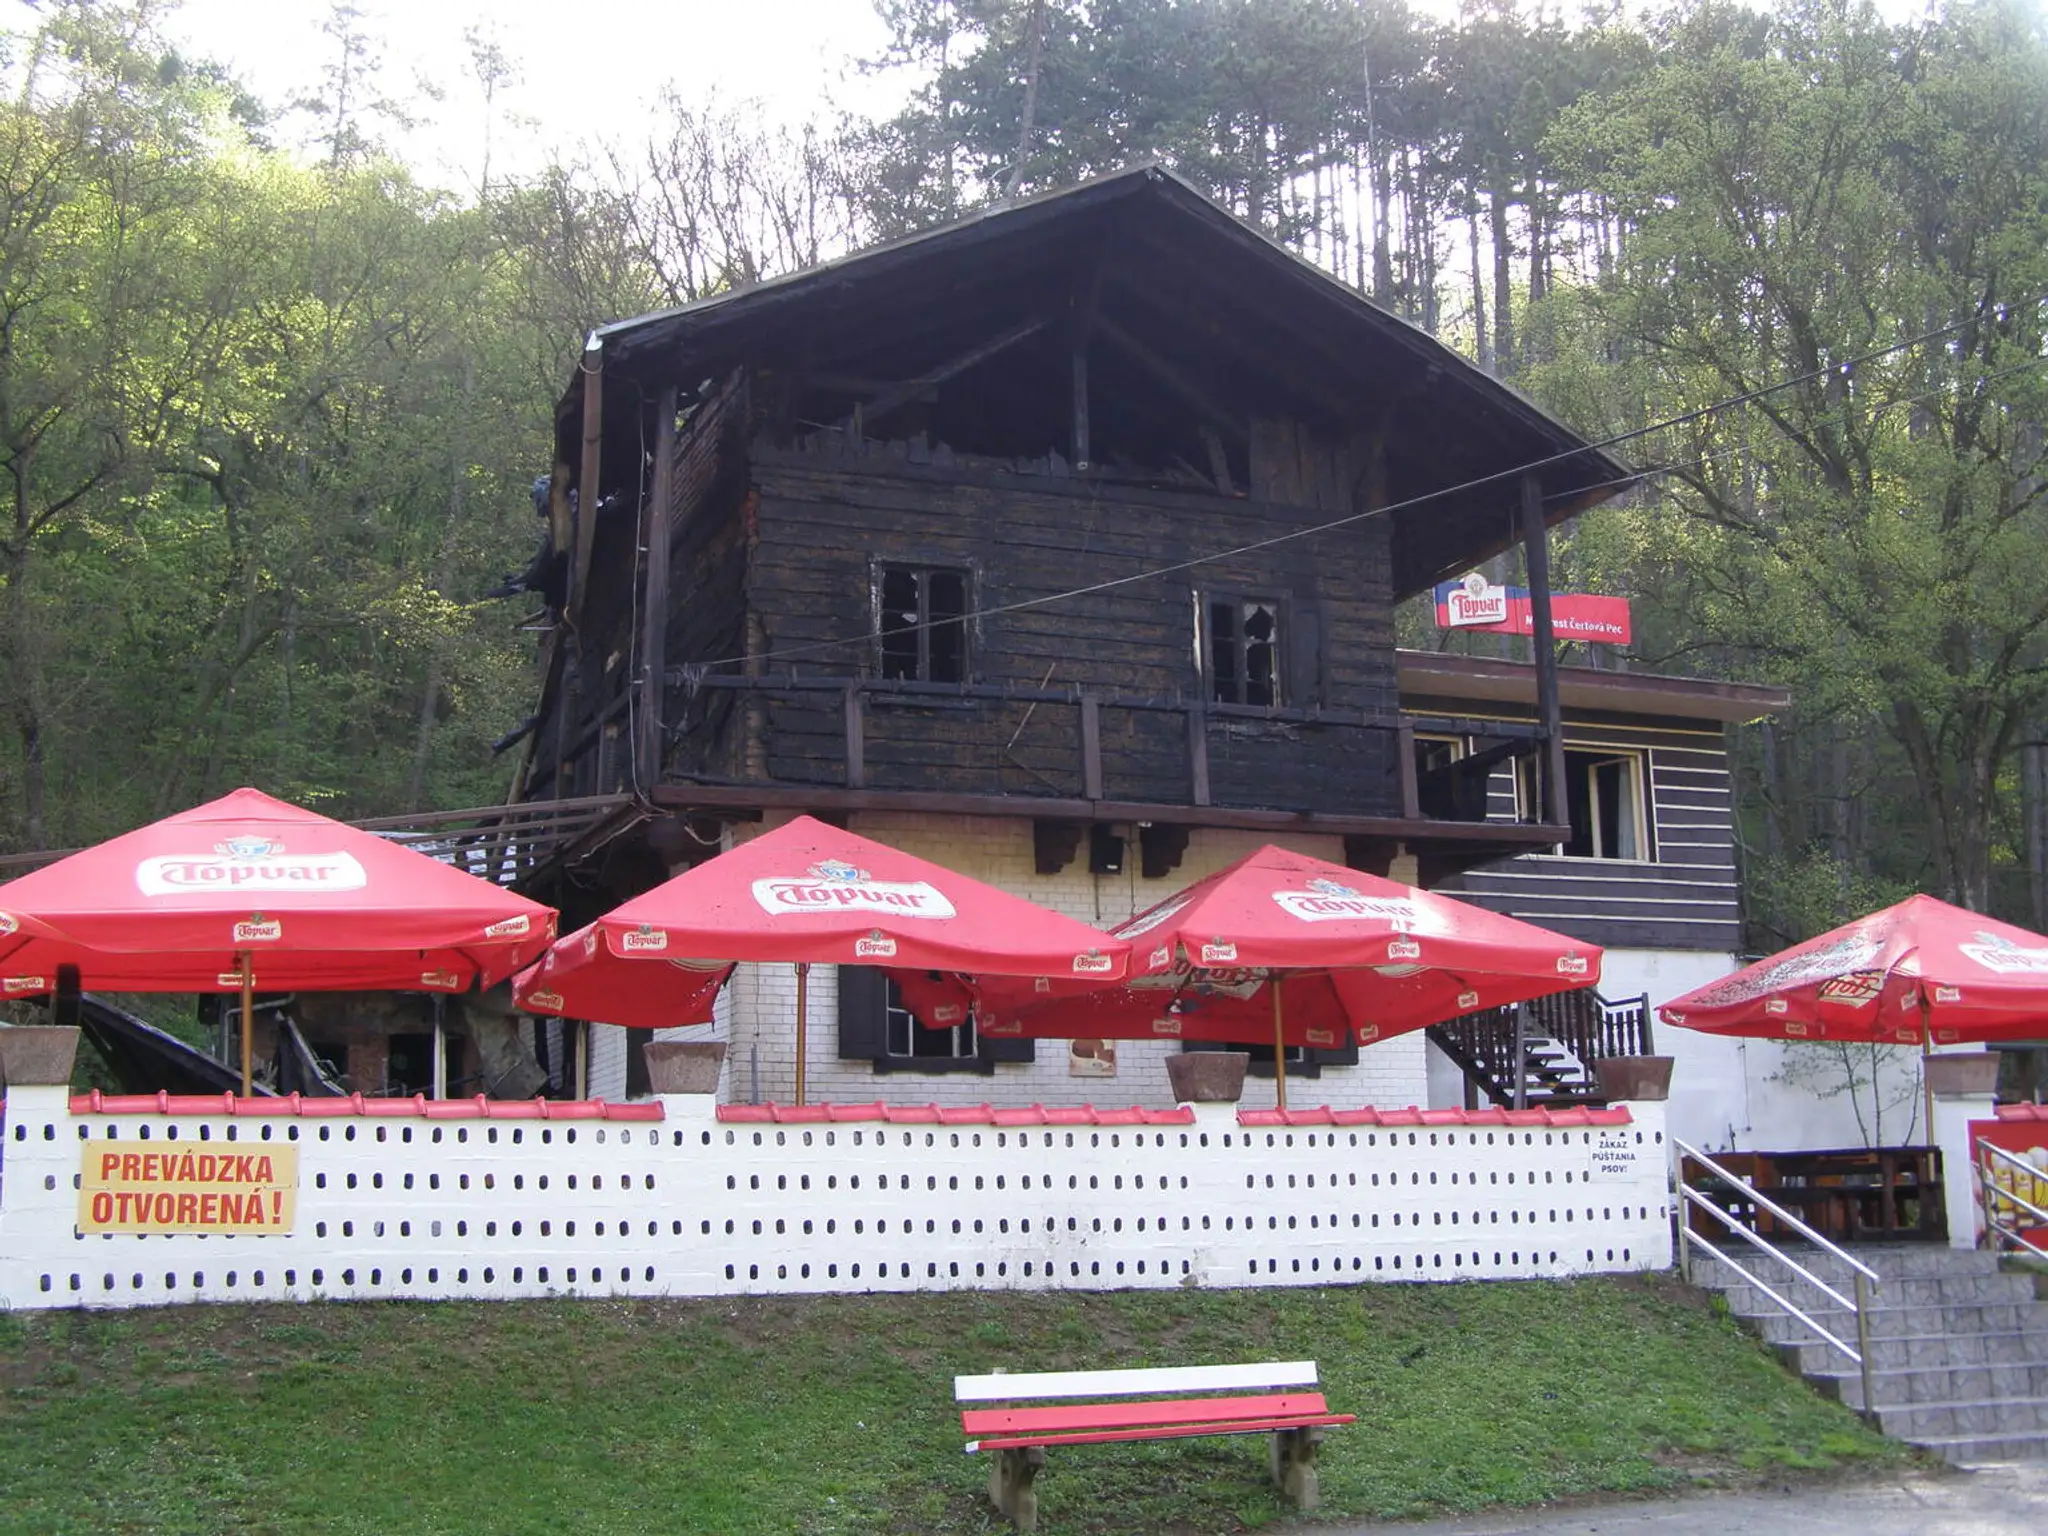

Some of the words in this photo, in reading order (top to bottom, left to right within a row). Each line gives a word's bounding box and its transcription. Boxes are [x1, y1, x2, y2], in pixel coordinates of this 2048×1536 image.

[1452, 594, 1502, 619] Topvar
[160, 861, 339, 885] Topvar
[770, 881, 927, 908] Topvar
[238, 924, 276, 938] Topvar
[627, 933, 662, 947] Topvar
[859, 940, 892, 953] Topvar
[101, 1148, 274, 1183] PREVÁDZKA
